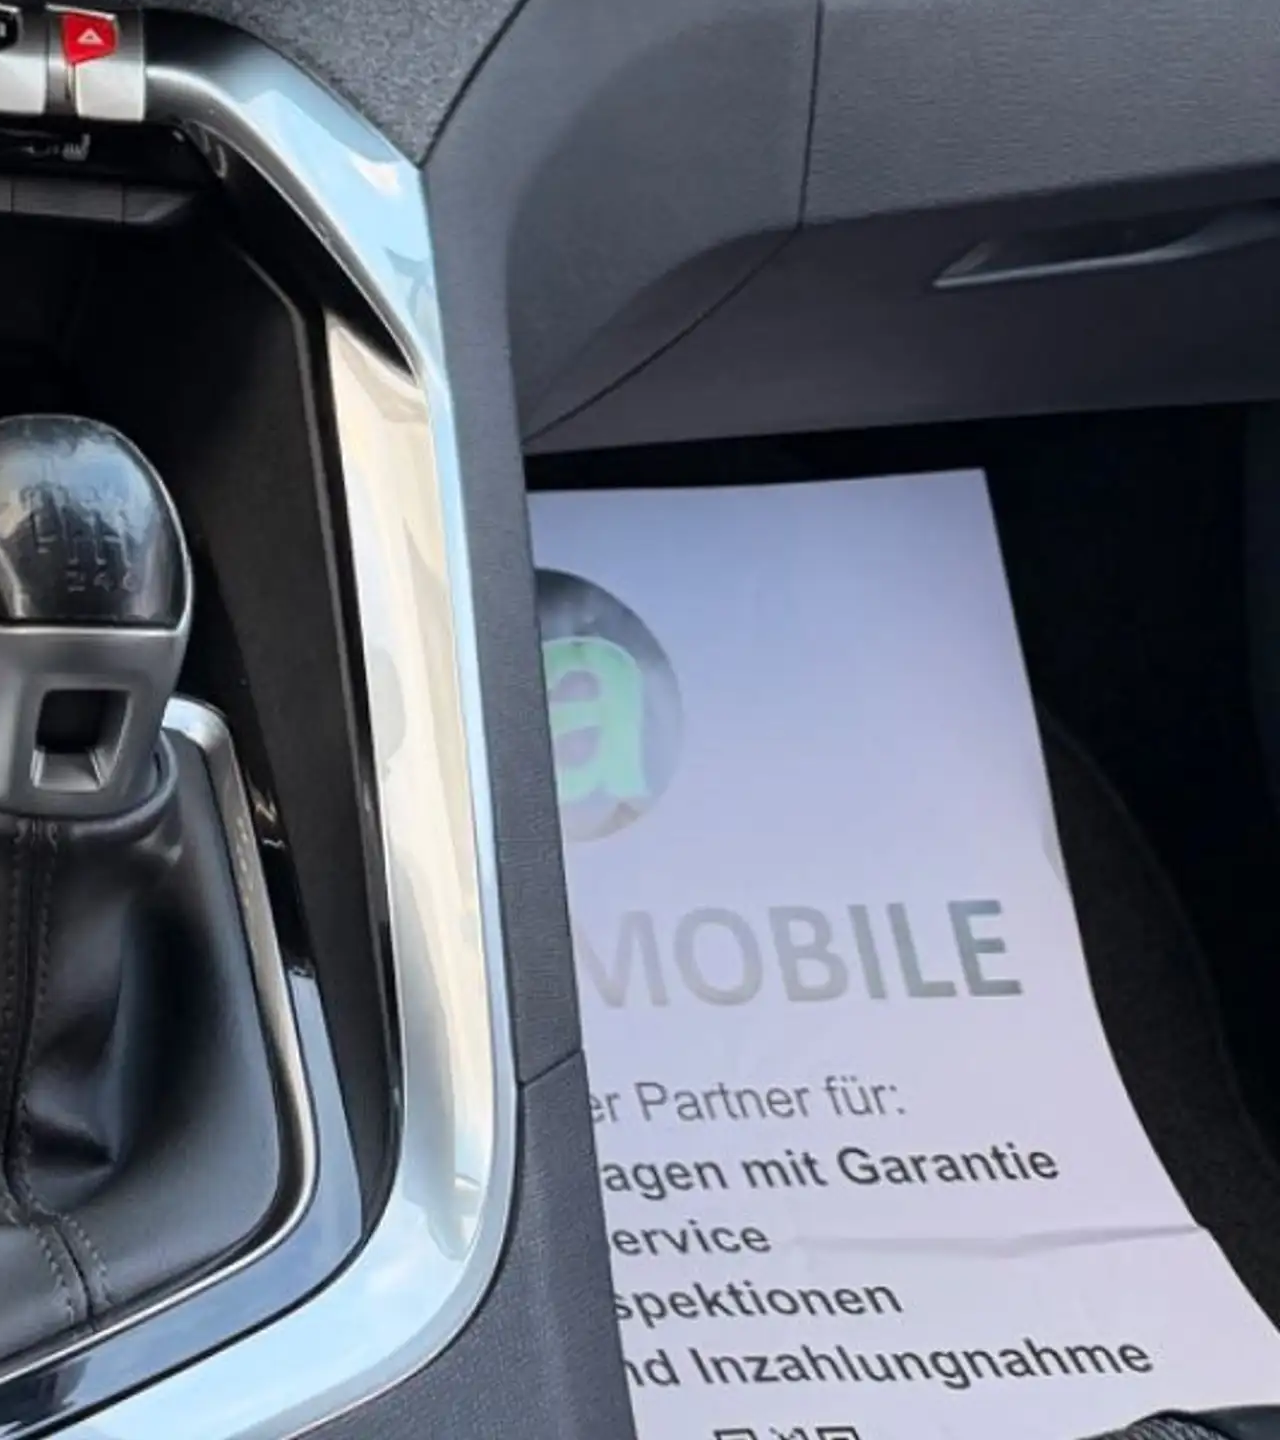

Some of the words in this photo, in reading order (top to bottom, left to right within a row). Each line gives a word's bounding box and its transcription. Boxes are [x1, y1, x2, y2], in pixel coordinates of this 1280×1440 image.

[634, 1080, 810, 1122] Partner
[825, 1074, 906, 1116] für:
[742, 1149, 829, 1188] mit
[836, 1142, 1060, 1185] Garantie
[687, 1336, 1154, 1391] Inzahlungnahme
